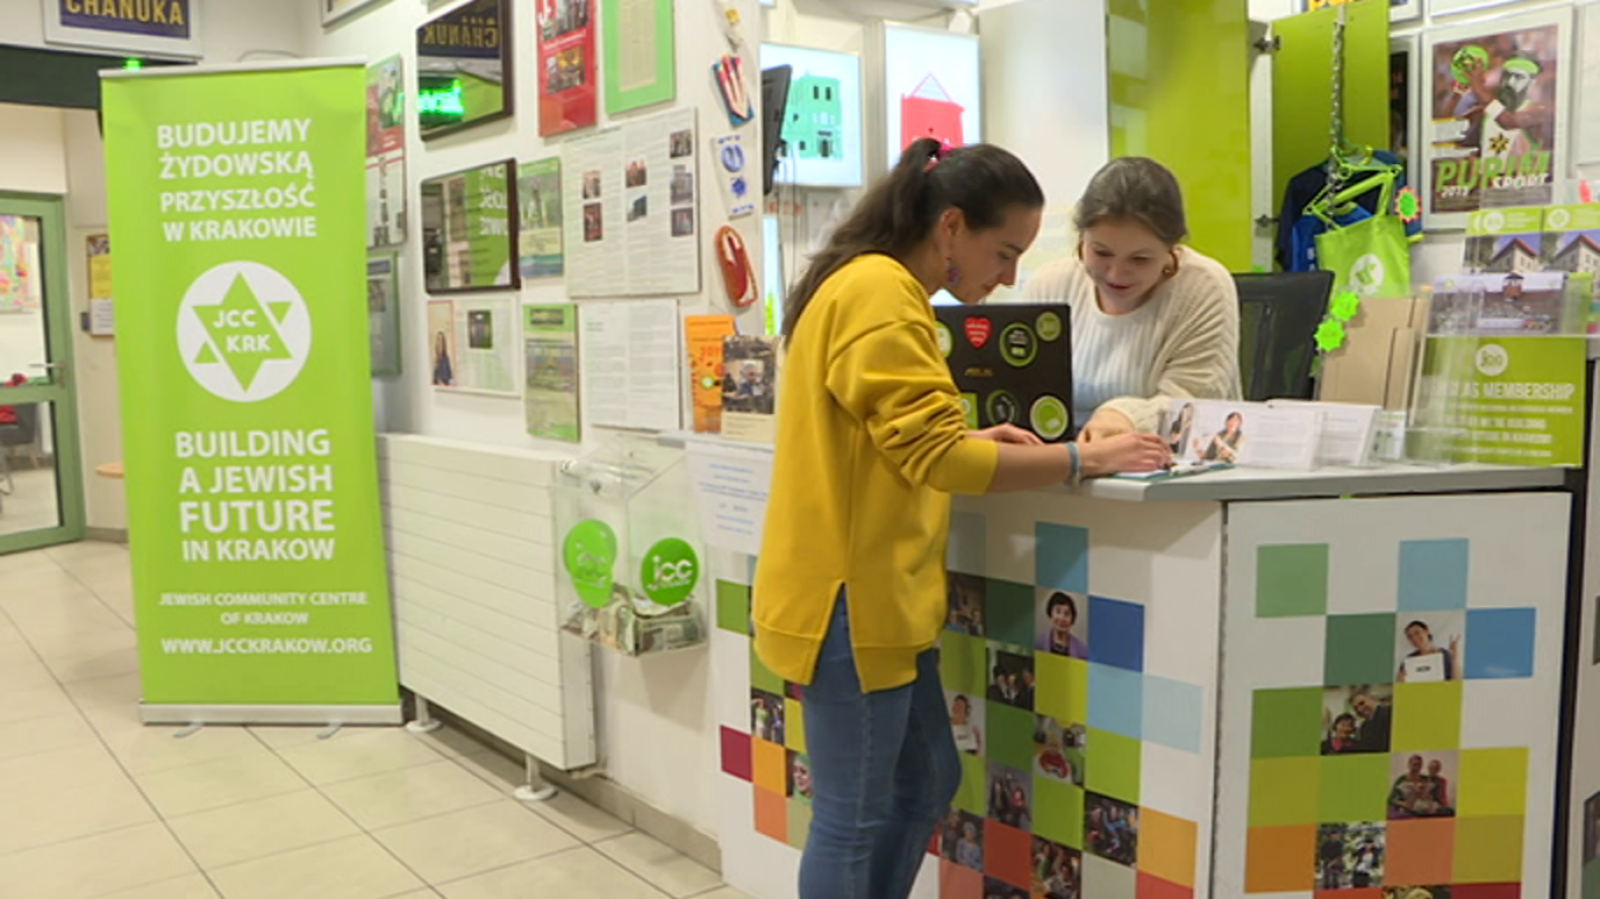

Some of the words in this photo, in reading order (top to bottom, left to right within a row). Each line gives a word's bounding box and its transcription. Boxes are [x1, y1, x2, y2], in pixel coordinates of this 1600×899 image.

[65, 0, 186, 25] CHANUKA
[157, 118, 311, 149] BUDUJEMY
[159, 150, 316, 180] ŻYDOWSKĄ
[160, 181, 317, 213] PRZYSZŁOŚĆ
[162, 220, 186, 242] W
[190, 215, 318, 241] KRAKOWIE
[212, 309, 257, 329] JCC
[226, 334, 273, 354] KRK
[1482, 382, 1576, 401] MEMBERSHIP
[175, 429, 330, 457] BUILDING
[179, 466, 202, 494] A
[207, 464, 334, 493] JEWISH
[179, 499, 336, 533] FUTURE
[181, 539, 211, 561] IN
[216, 537, 336, 561] KRAKOW
[647, 555, 693, 591] jcc
[160, 593, 210, 606] JEWISH
[214, 592, 306, 606] COMMUNITY
[311, 592, 368, 605] CENTRE
[220, 612, 242, 625] OF
[245, 612, 309, 624] KRAKOW
[161, 636, 374, 655] WWW.JCCKRAKOW.ORG
